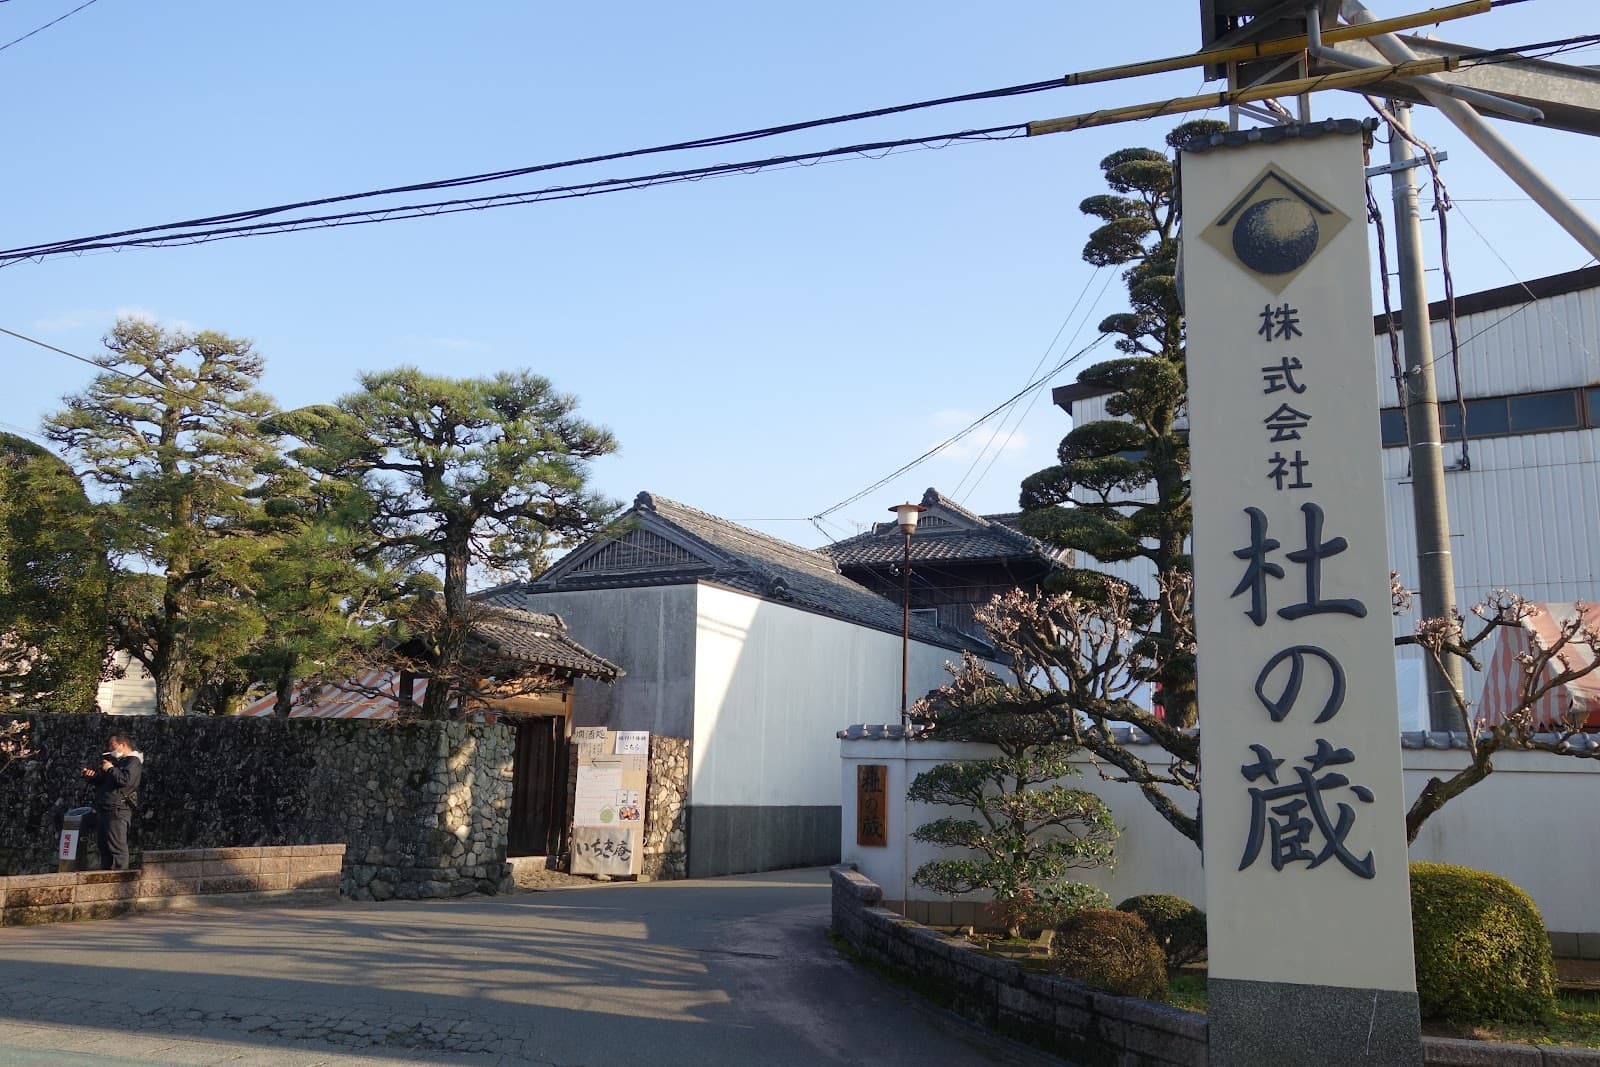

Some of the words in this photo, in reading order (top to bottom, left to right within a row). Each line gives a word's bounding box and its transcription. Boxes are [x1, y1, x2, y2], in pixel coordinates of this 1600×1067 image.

[1258, 303, 1313, 491] 株式会社
[1231, 502, 1376, 880] 杜の蔵
